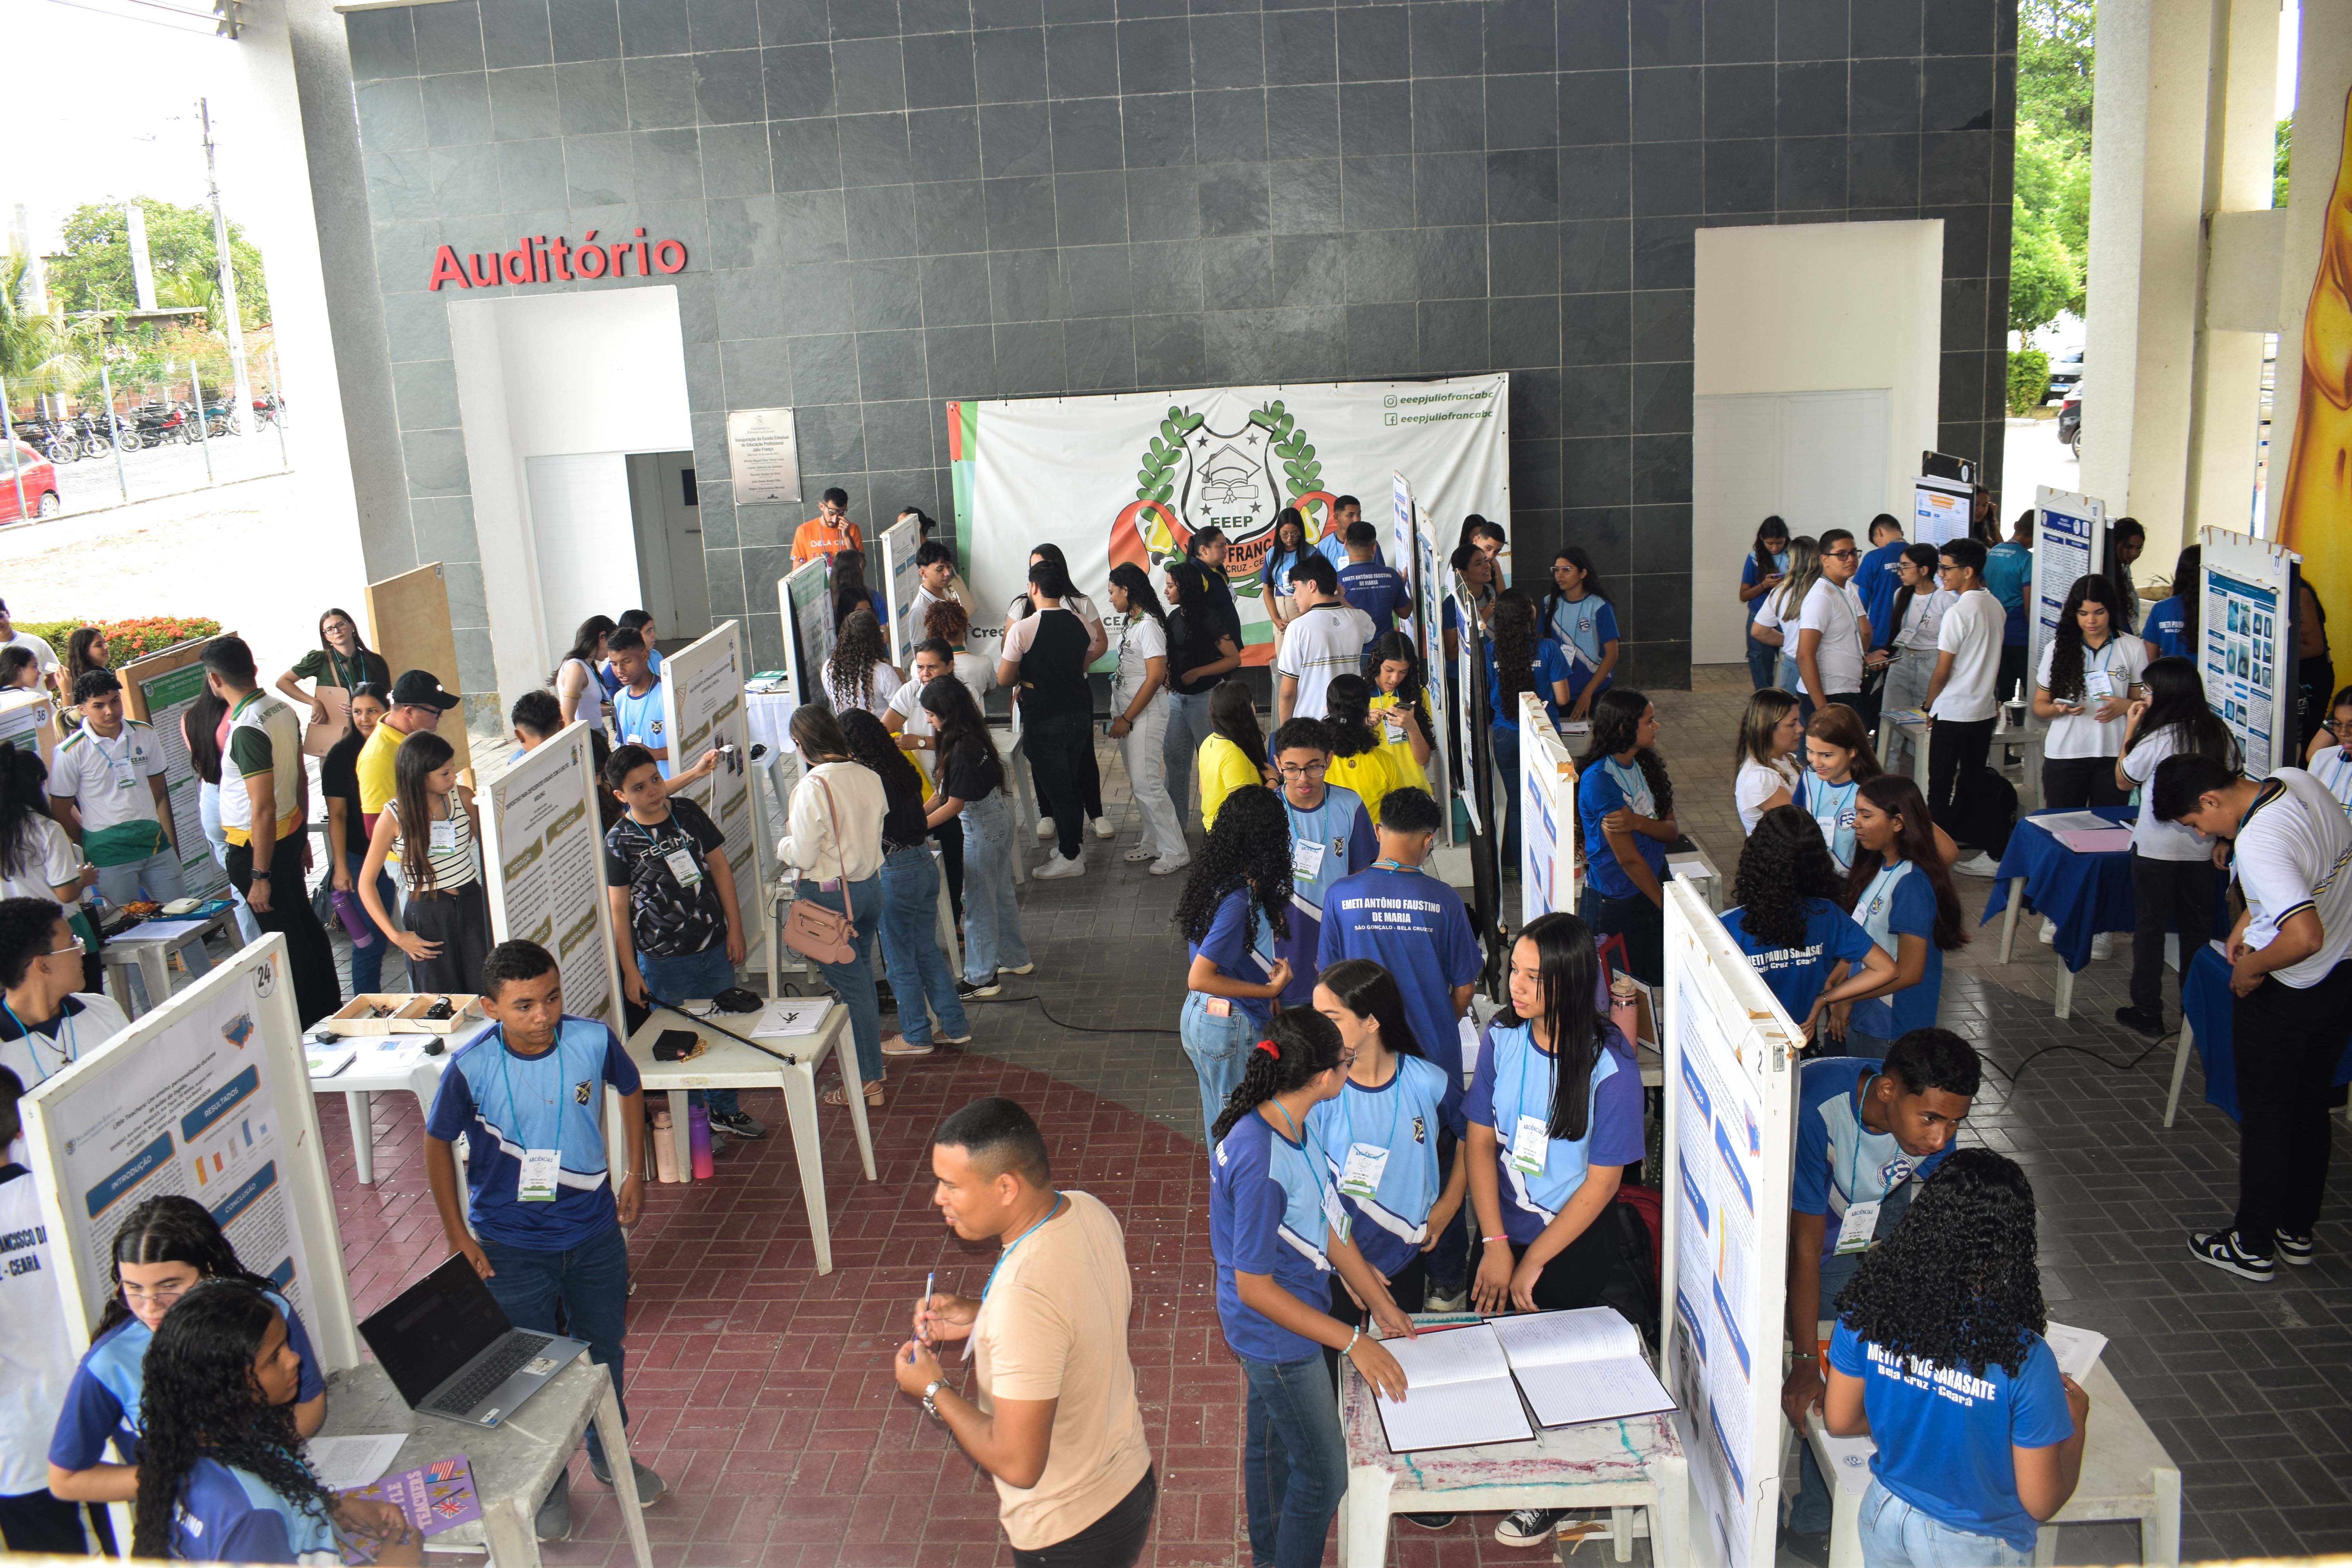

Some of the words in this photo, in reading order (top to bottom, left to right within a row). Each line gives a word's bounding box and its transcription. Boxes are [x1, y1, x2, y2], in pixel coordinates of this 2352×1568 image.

[429, 227, 687, 291] Auditório
[1400, 391, 1493, 405] eeepjuliofrancabc
[1401, 410, 1493, 423] eeepjuliofrancabc
[1210, 516, 1253, 528] EEEP
[1226, 564, 1247, 573] CRUZ
[1254, 558, 1264, 567] CE
[37, 710, 45, 721] 36
[1341, 898, 1363, 910] EMETI
[1364, 897, 1401, 909] ANTÔNIO
[1403, 899, 1441, 913] FAUSTINO
[1372, 912, 1384, 922] DE
[1385, 912, 1411, 923] MARIA
[1765, 949, 1789, 963] PAULO
[258, 963, 270, 988] 24
[156, 1086, 171, 1098] ensino
[172, 1064, 201, 1088] personalizado
[205, 1087, 238, 1118] RESULTADOS
[1524, 1124, 1543, 1135] ABCIÊNCIAS
[111, 1155, 152, 1191] INTRODUÇÃO
[225, 1183, 256, 1214] CONCLUSÃO
[1851, 1209, 1873, 1217] ABCIÊNCIAS
[9, 1252, 41, 1276] CEARÁ
[1878, 1364, 1900, 1380] Bela
[1904, 1375, 1929, 1390] Cruz
[1938, 1386, 1973, 1407] Ceará
[1894, 1353, 1933, 1378] PULO
[1934, 1365, 1996, 1401] SARASATE
[406, 1470, 433, 1529] TEACHERS
